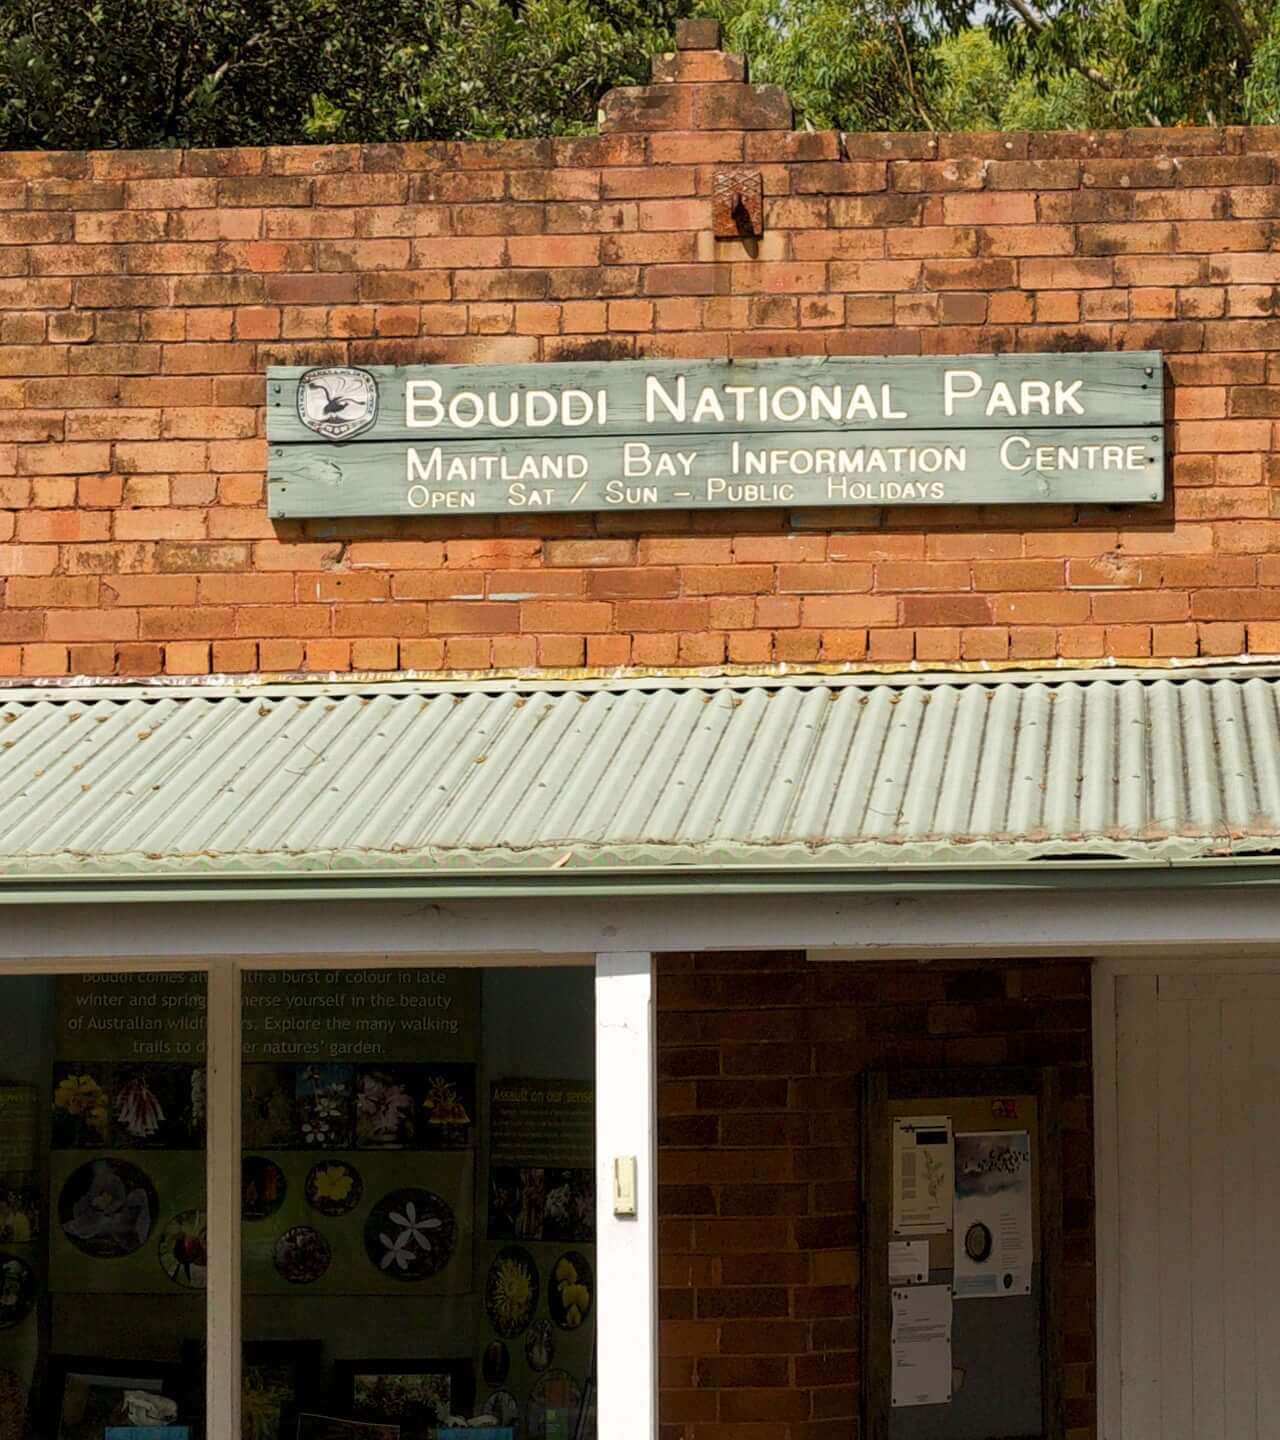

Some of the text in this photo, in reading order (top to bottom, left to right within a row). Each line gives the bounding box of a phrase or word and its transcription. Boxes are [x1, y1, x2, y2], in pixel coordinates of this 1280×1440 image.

[282, 971, 320, 984] burst
[326, 971, 339, 984] of
[345, 971, 392, 984] colour
[398, 971, 411, 984] in
[417, 970, 447, 984] late
[76, 991, 124, 1007] winter
[129, 992, 157, 1007] and
[287, 992, 345, 1009] yourself
[352, 992, 365, 1007] in
[370, 992, 395, 1007] the
[400, 992, 453, 1009] beauty
[67, 1015, 83, 1031] of
[87, 1015, 162, 1030] Australian
[265, 1016, 321, 1033] Explore
[326, 1016, 352, 1030] the
[356, 1018, 396, 1033] many
[400, 1016, 459, 1034] walking
[133, 1039, 171, 1054] trails
[176, 1040, 192, 1054] to
